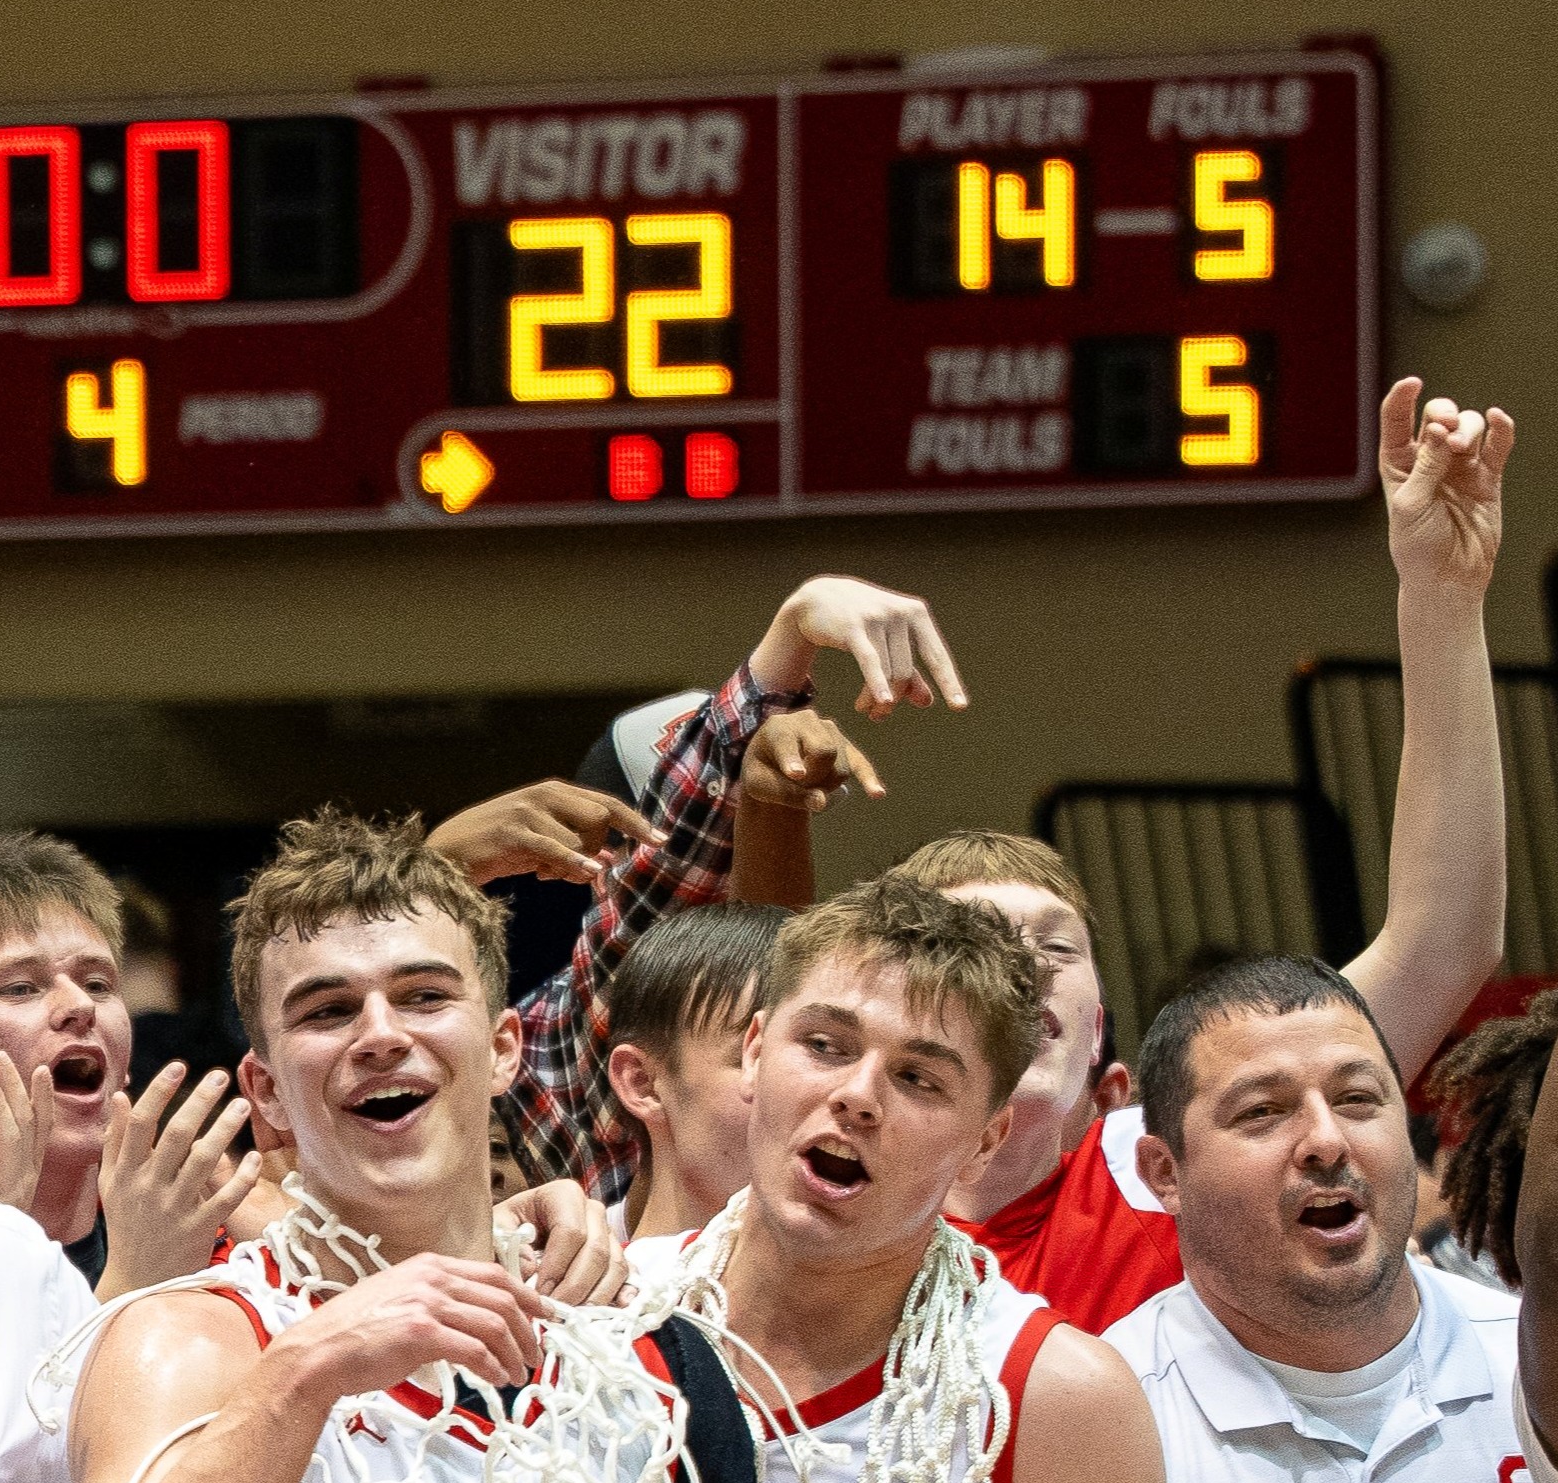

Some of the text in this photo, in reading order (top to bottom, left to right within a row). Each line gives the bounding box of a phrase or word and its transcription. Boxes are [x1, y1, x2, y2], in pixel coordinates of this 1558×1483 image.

[453, 113, 746, 205] VISITOR
[898, 79, 1312, 150] PLAYER FOULS
[960, 151, 1272, 289] 14 5
[510, 214, 730, 401] 22
[178, 394, 323, 443] PERIOD
[926, 347, 1069, 405] TEAM
[1181, 337, 1258, 465] 5
[67, 361, 144, 485] 4
[908, 413, 1069, 474] FOULS
